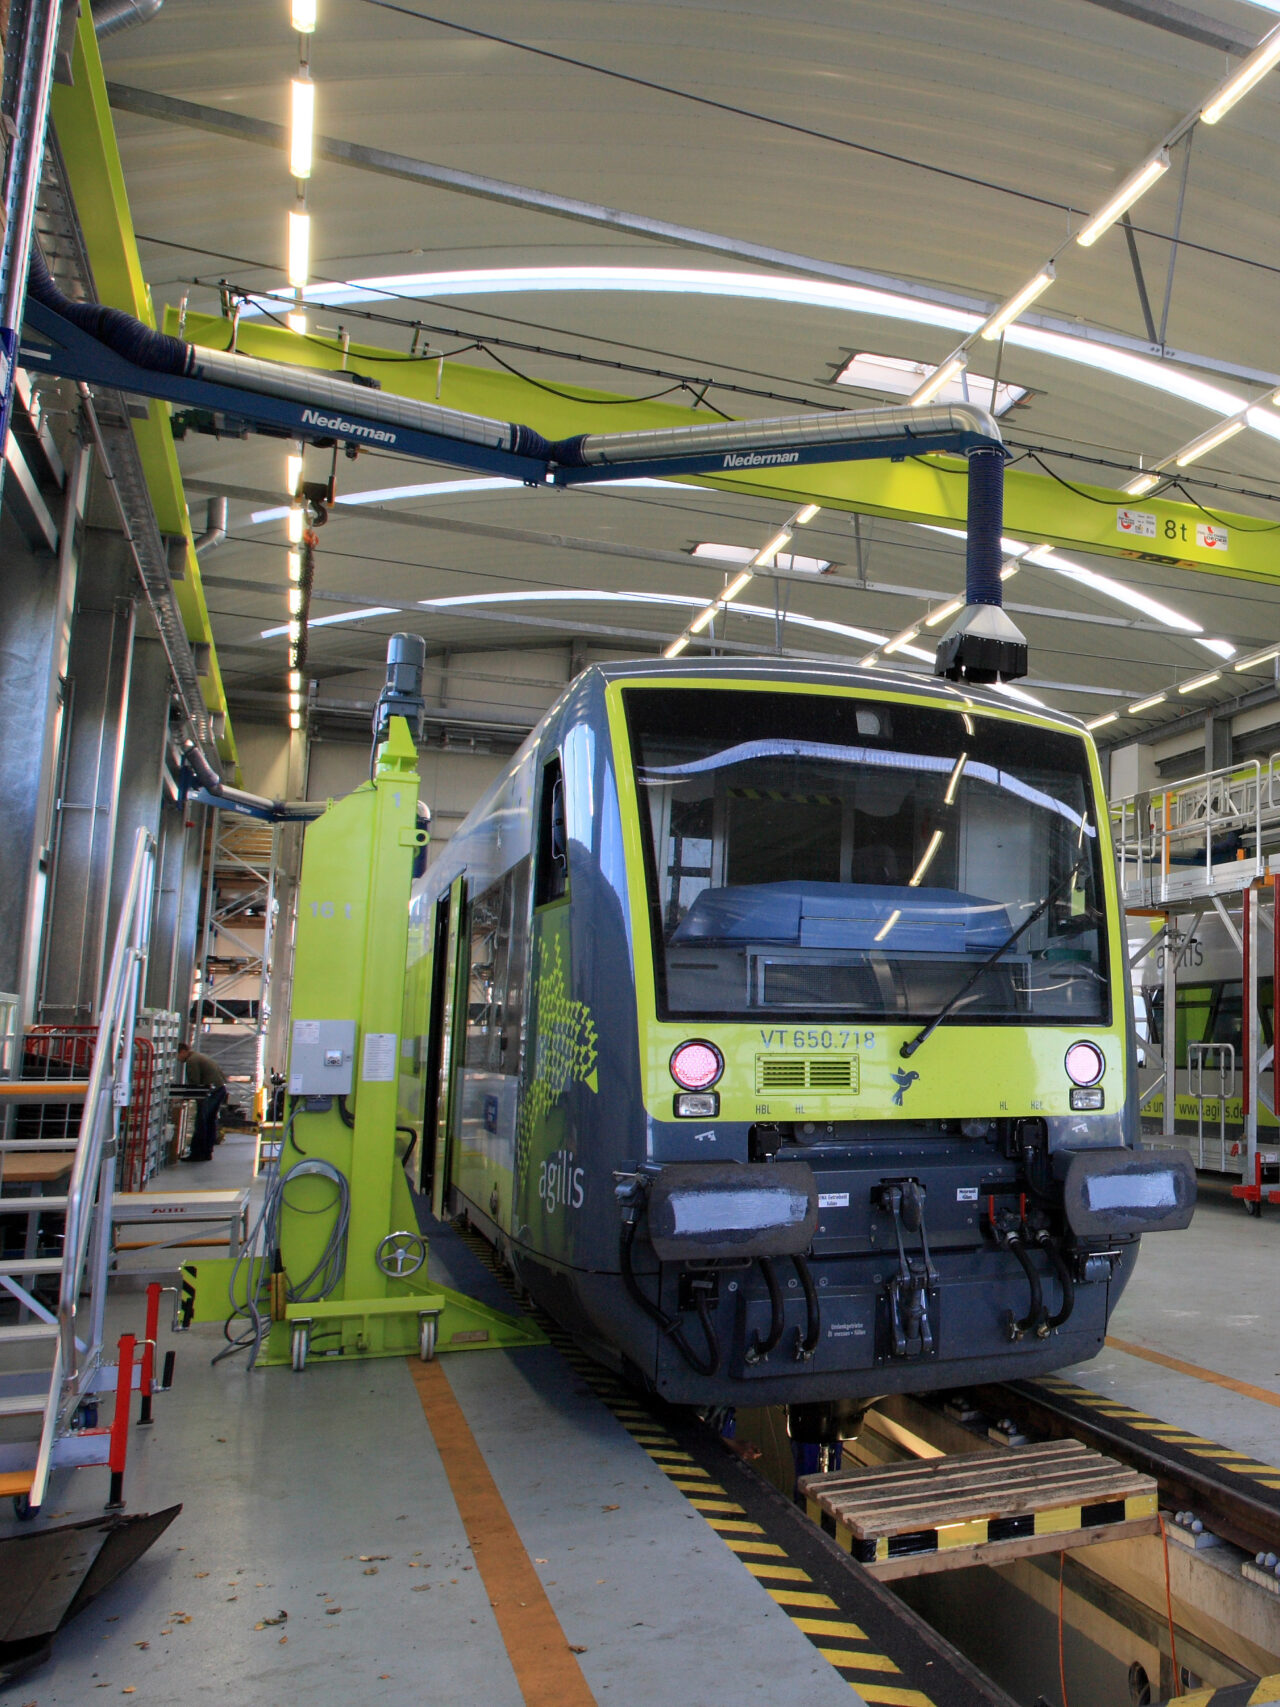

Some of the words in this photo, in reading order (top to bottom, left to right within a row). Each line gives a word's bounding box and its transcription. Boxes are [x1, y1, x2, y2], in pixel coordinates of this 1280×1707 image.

[301, 409, 397, 444] Nederman
[723, 451, 799, 468] Nederman
[308, 900, 335, 919] 16
[760, 1030, 788, 1049] VT
[793, 1030, 876, 1049] 650.718
[755, 1104, 771, 1115] HBL
[795, 1104, 806, 1115] HL
[538, 1150, 585, 1213] agilis
